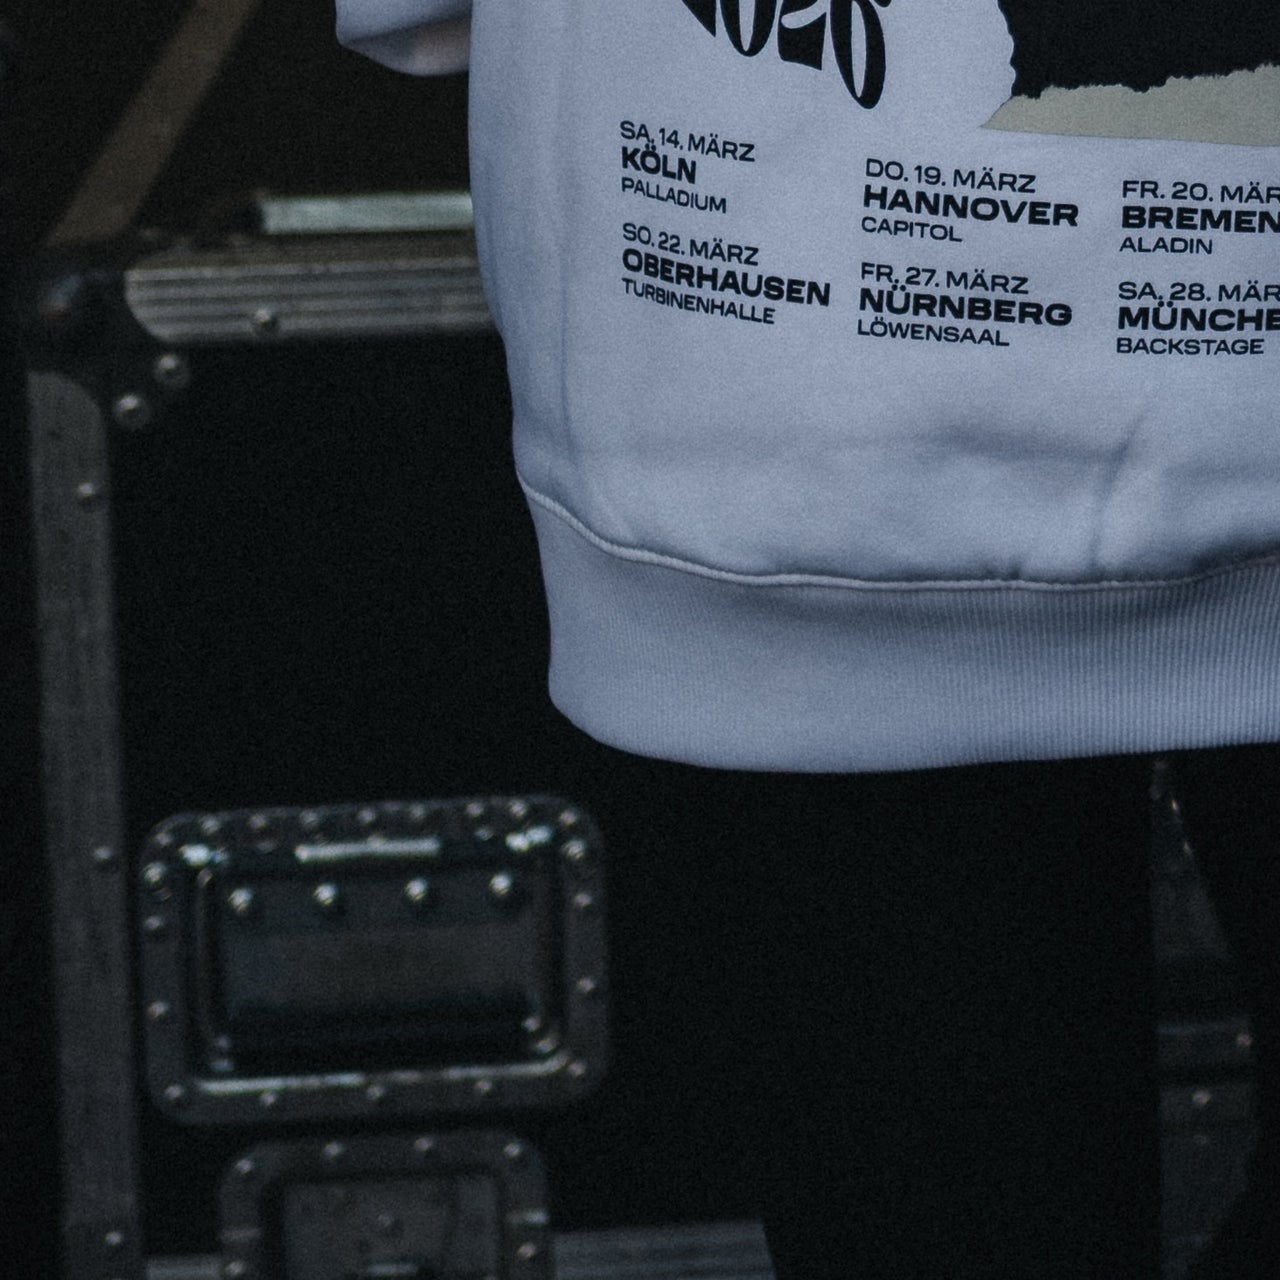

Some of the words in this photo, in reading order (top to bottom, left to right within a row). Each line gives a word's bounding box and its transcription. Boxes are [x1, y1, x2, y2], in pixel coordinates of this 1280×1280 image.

[620, 120, 655, 145] SA.
[658, 128, 684, 150] 14.
[688, 133, 755, 162] MÄRZ
[621, 144, 696, 184] KÖLN
[866, 158, 909, 183] DO.
[914, 166, 946, 187] 19.
[954, 166, 1036, 194] MÄRZ
[621, 177, 727, 214] PALLADIUM
[864, 185, 1079, 227] HANNOVER
[1122, 180, 1165, 200] FR.
[1171, 181, 1213, 202] 20.
[622, 223, 654, 247] SO.
[659, 232, 685, 255] 22.
[690, 238, 759, 266] MÄRZ
[861, 216, 962, 242] CAPITOL
[1119, 237, 1213, 254] ALADIN
[622, 248, 830, 306] OBERHAUSEN
[861, 262, 899, 284] FR.
[906, 267, 940, 288] 27.
[947, 269, 1029, 295] MÄRZ
[1118, 282, 1164, 301] SA.
[1169, 283, 1212, 301] 28.
[621, 278, 775, 325] TURBINENHALLE
[860, 285, 1073, 327] NÜRNBERG
[857, 317, 1009, 347] LÖWENSAAL
[1117, 338, 1264, 355] BACKSTAGE
